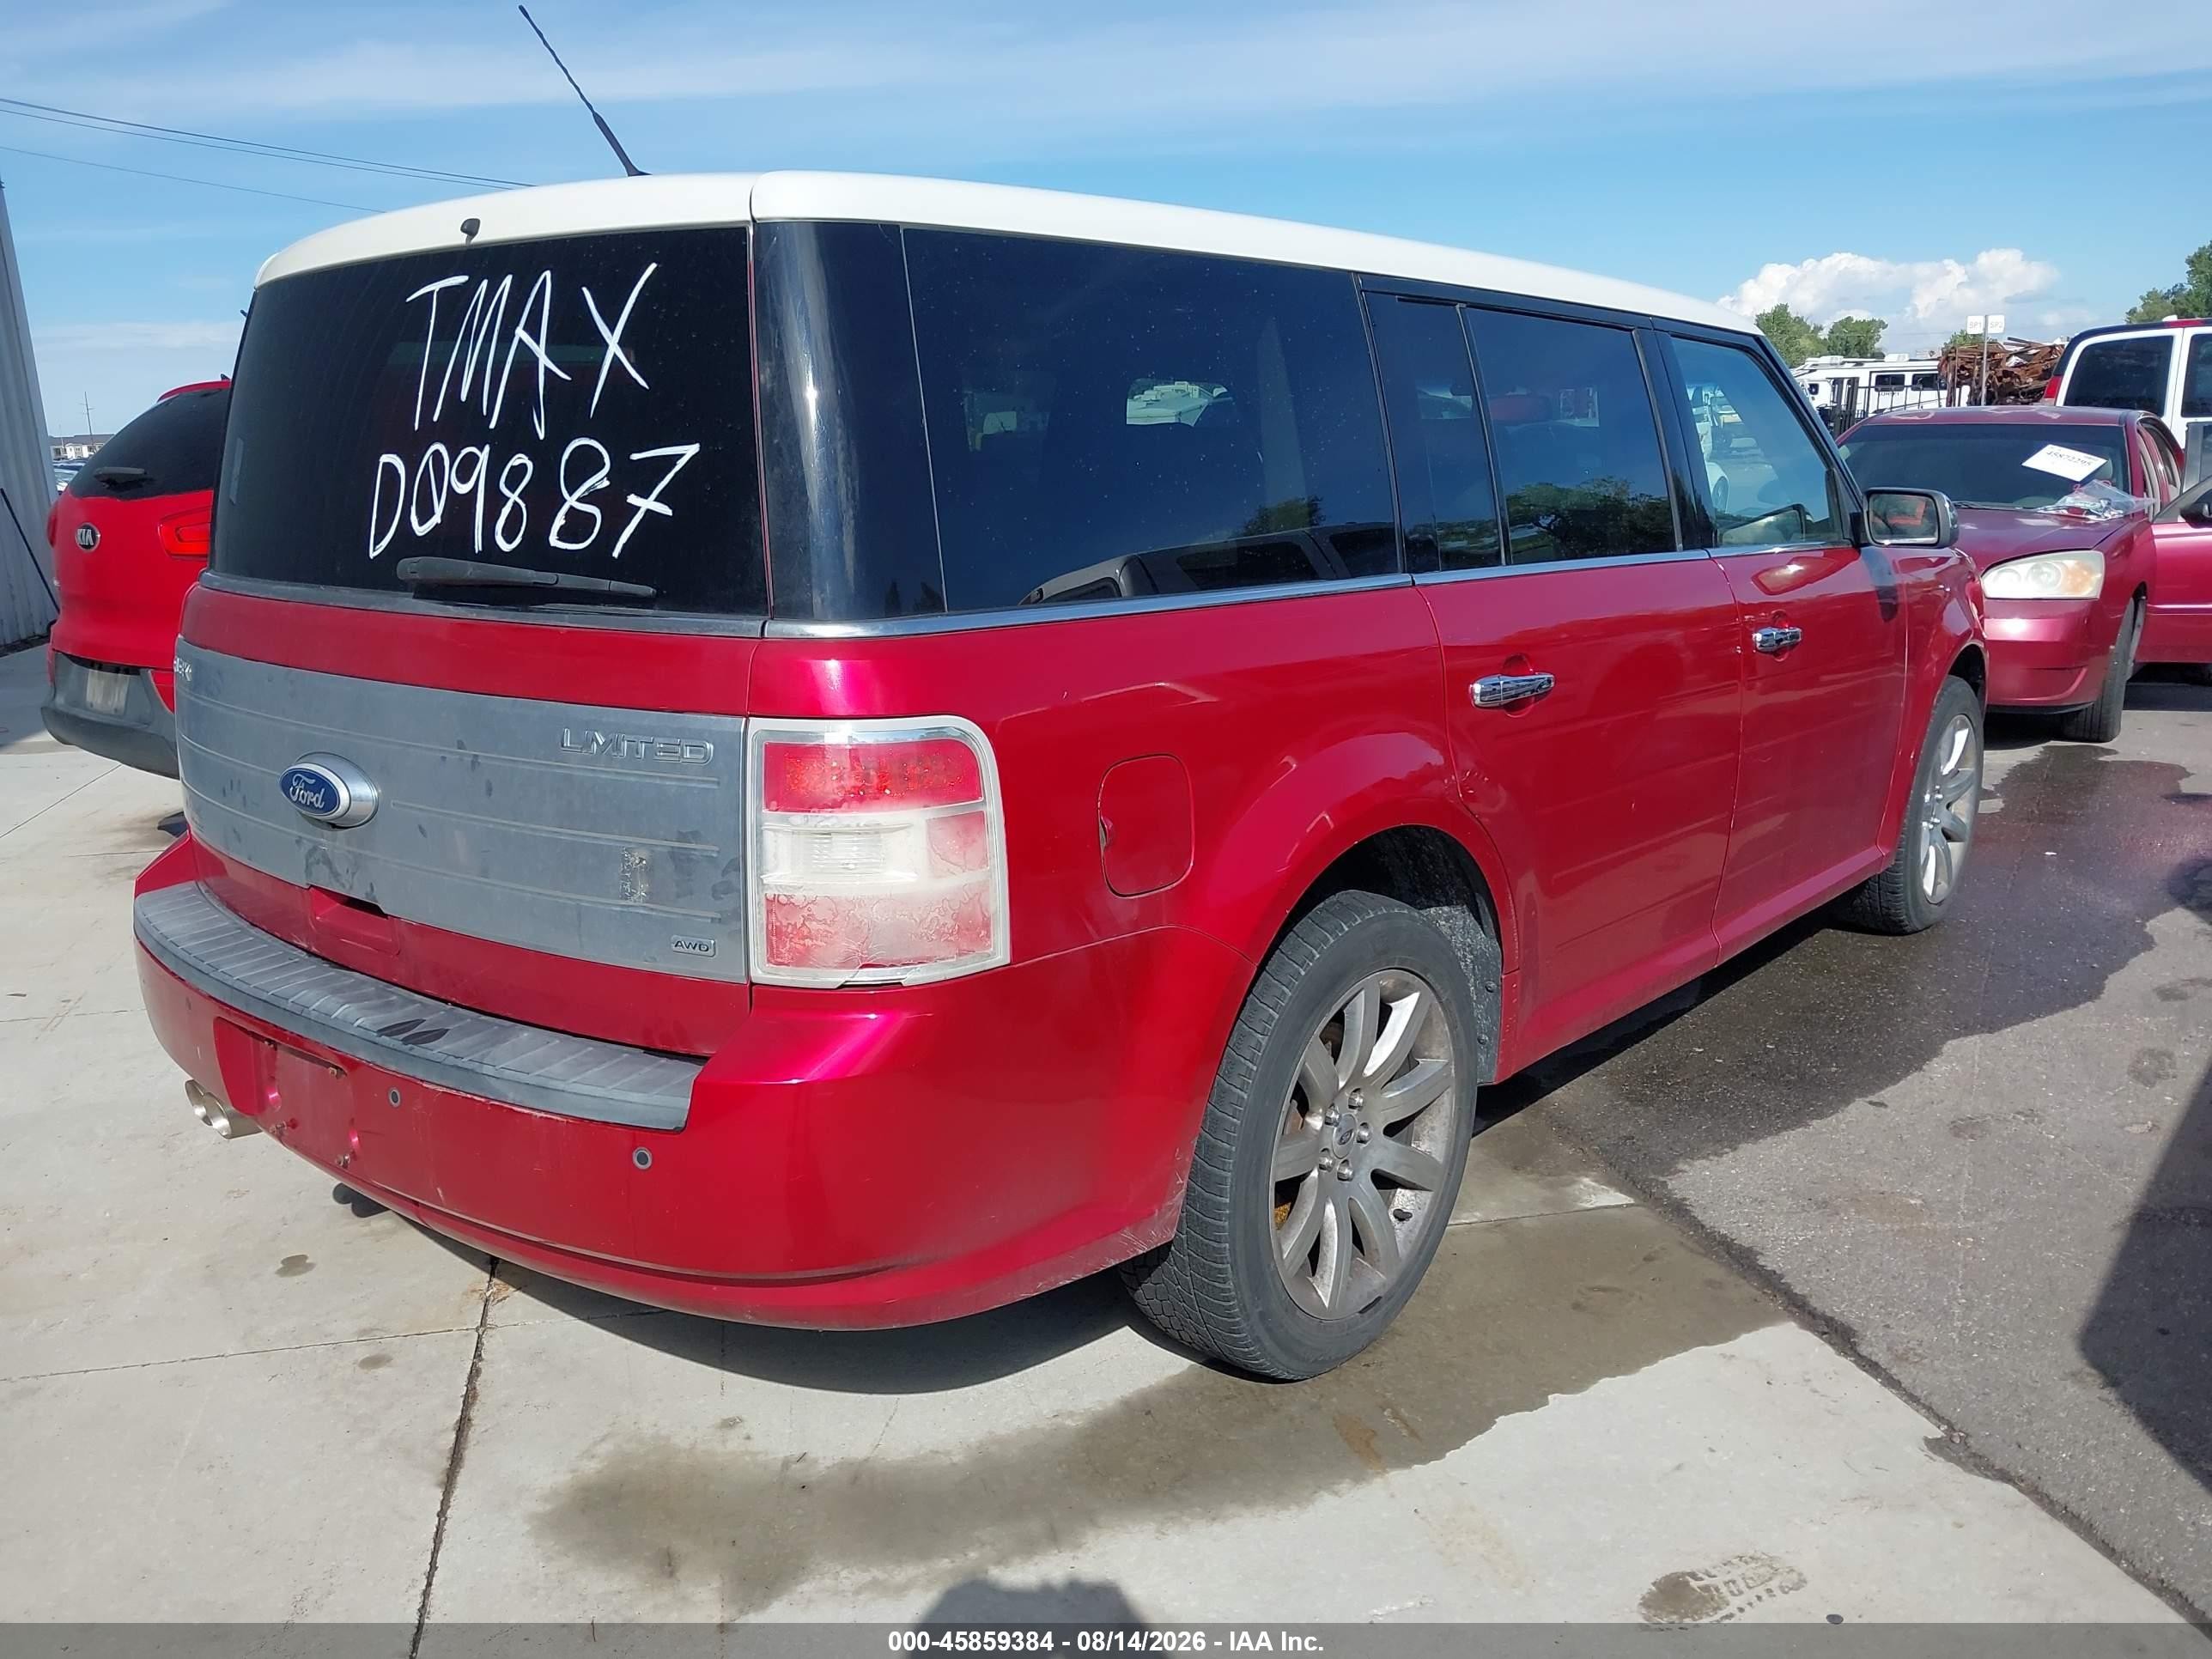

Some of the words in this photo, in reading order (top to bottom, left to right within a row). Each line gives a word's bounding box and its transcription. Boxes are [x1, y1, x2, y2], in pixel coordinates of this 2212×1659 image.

[405, 262, 658, 440] TMAX
[368, 436, 701, 559] D09887
[77, 528, 94, 545] KIA
[561, 727, 714, 766] LIMITED
[289, 773, 325, 809] Ford
[673, 939, 710, 952] AWD
